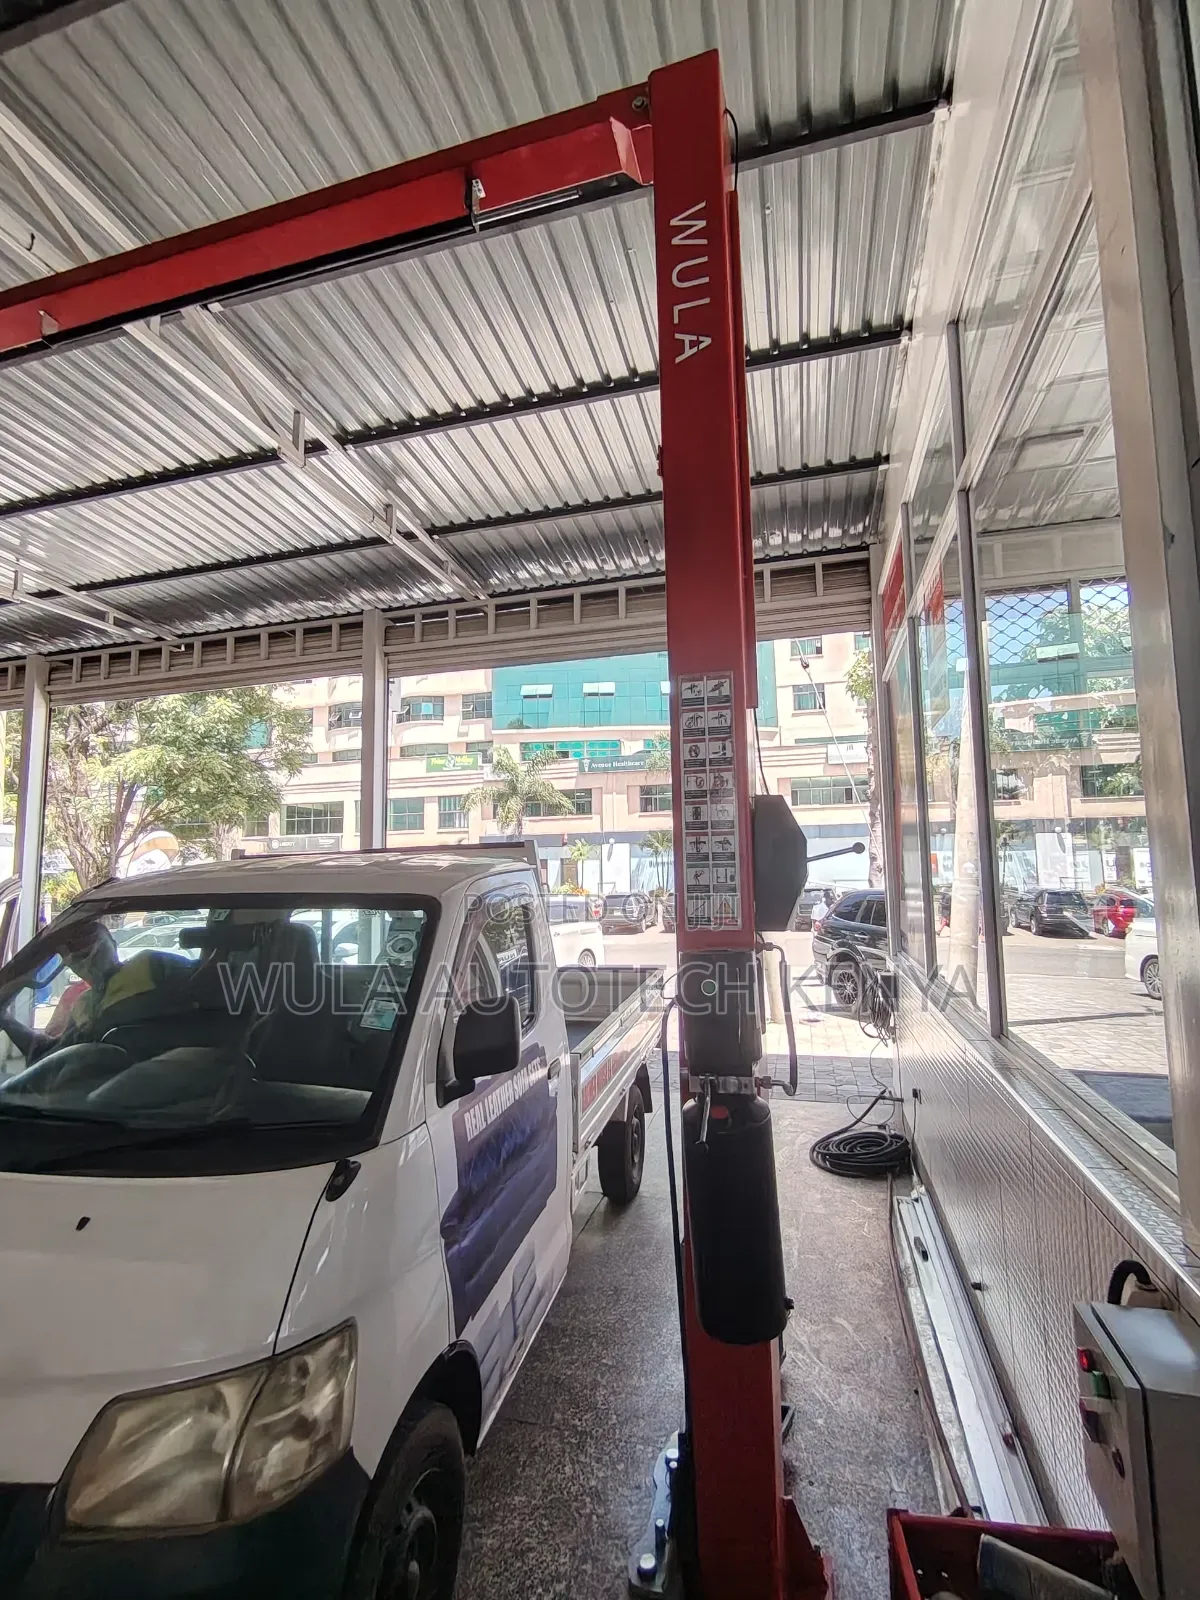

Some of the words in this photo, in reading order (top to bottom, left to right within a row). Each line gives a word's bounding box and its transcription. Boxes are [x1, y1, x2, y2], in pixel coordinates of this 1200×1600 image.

[669, 200, 712, 364] WULA
[463, 1101, 487, 1142] REAL
[484, 1079, 515, 1125] LEATHER
